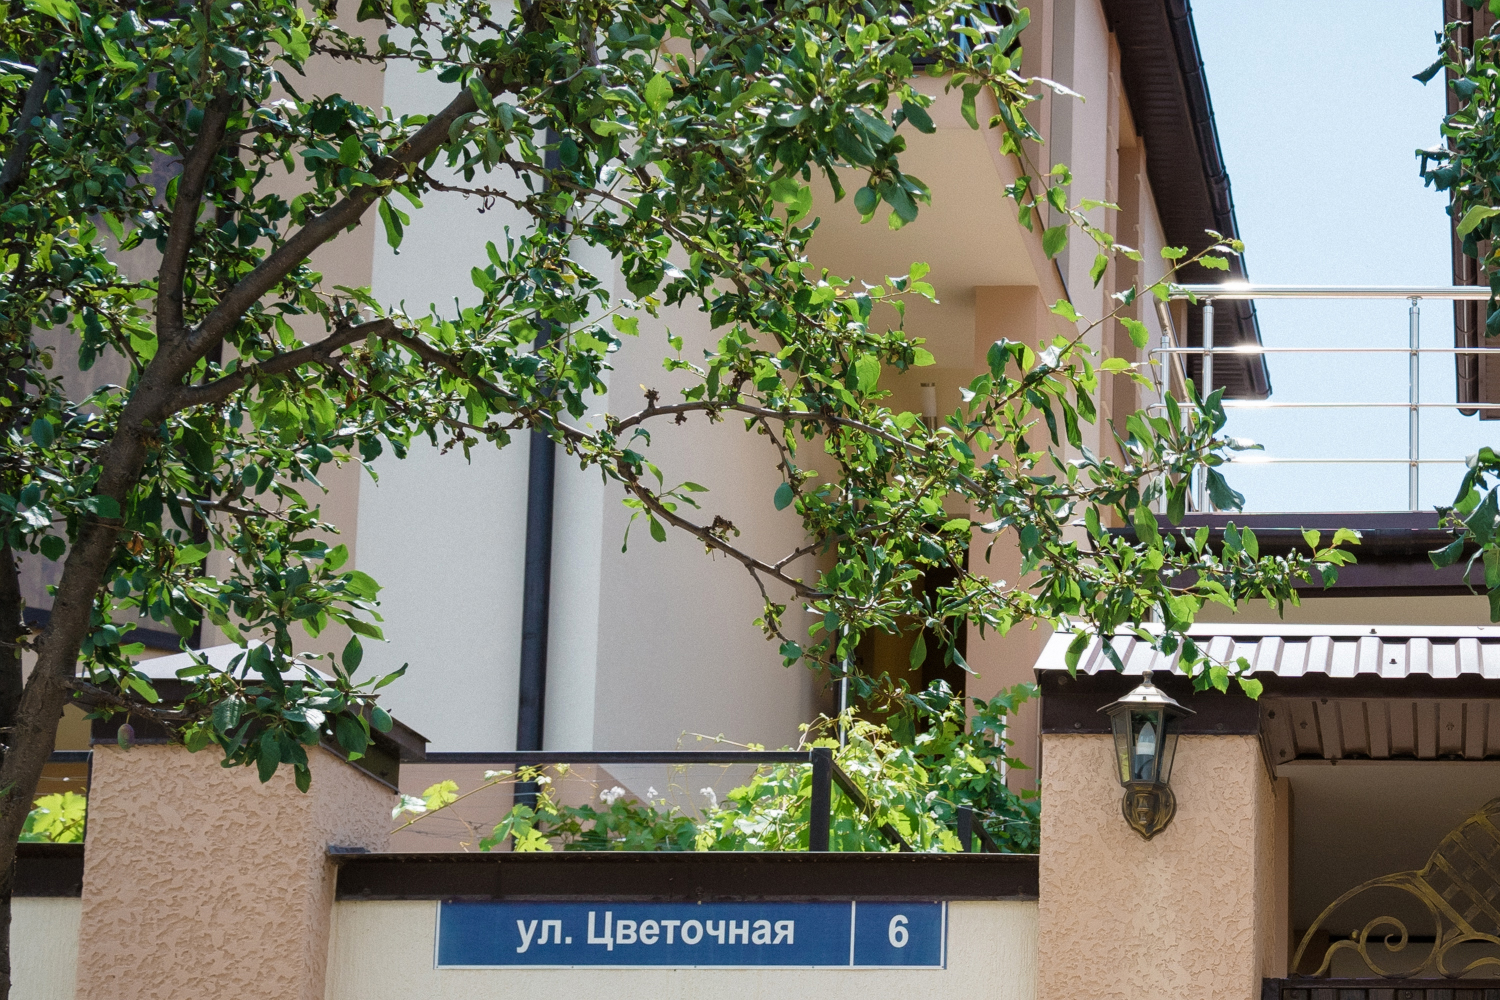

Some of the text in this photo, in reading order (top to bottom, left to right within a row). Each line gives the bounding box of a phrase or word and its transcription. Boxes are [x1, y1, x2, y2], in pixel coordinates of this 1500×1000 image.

[516, 911, 909, 954] ул. Цветочная 6
